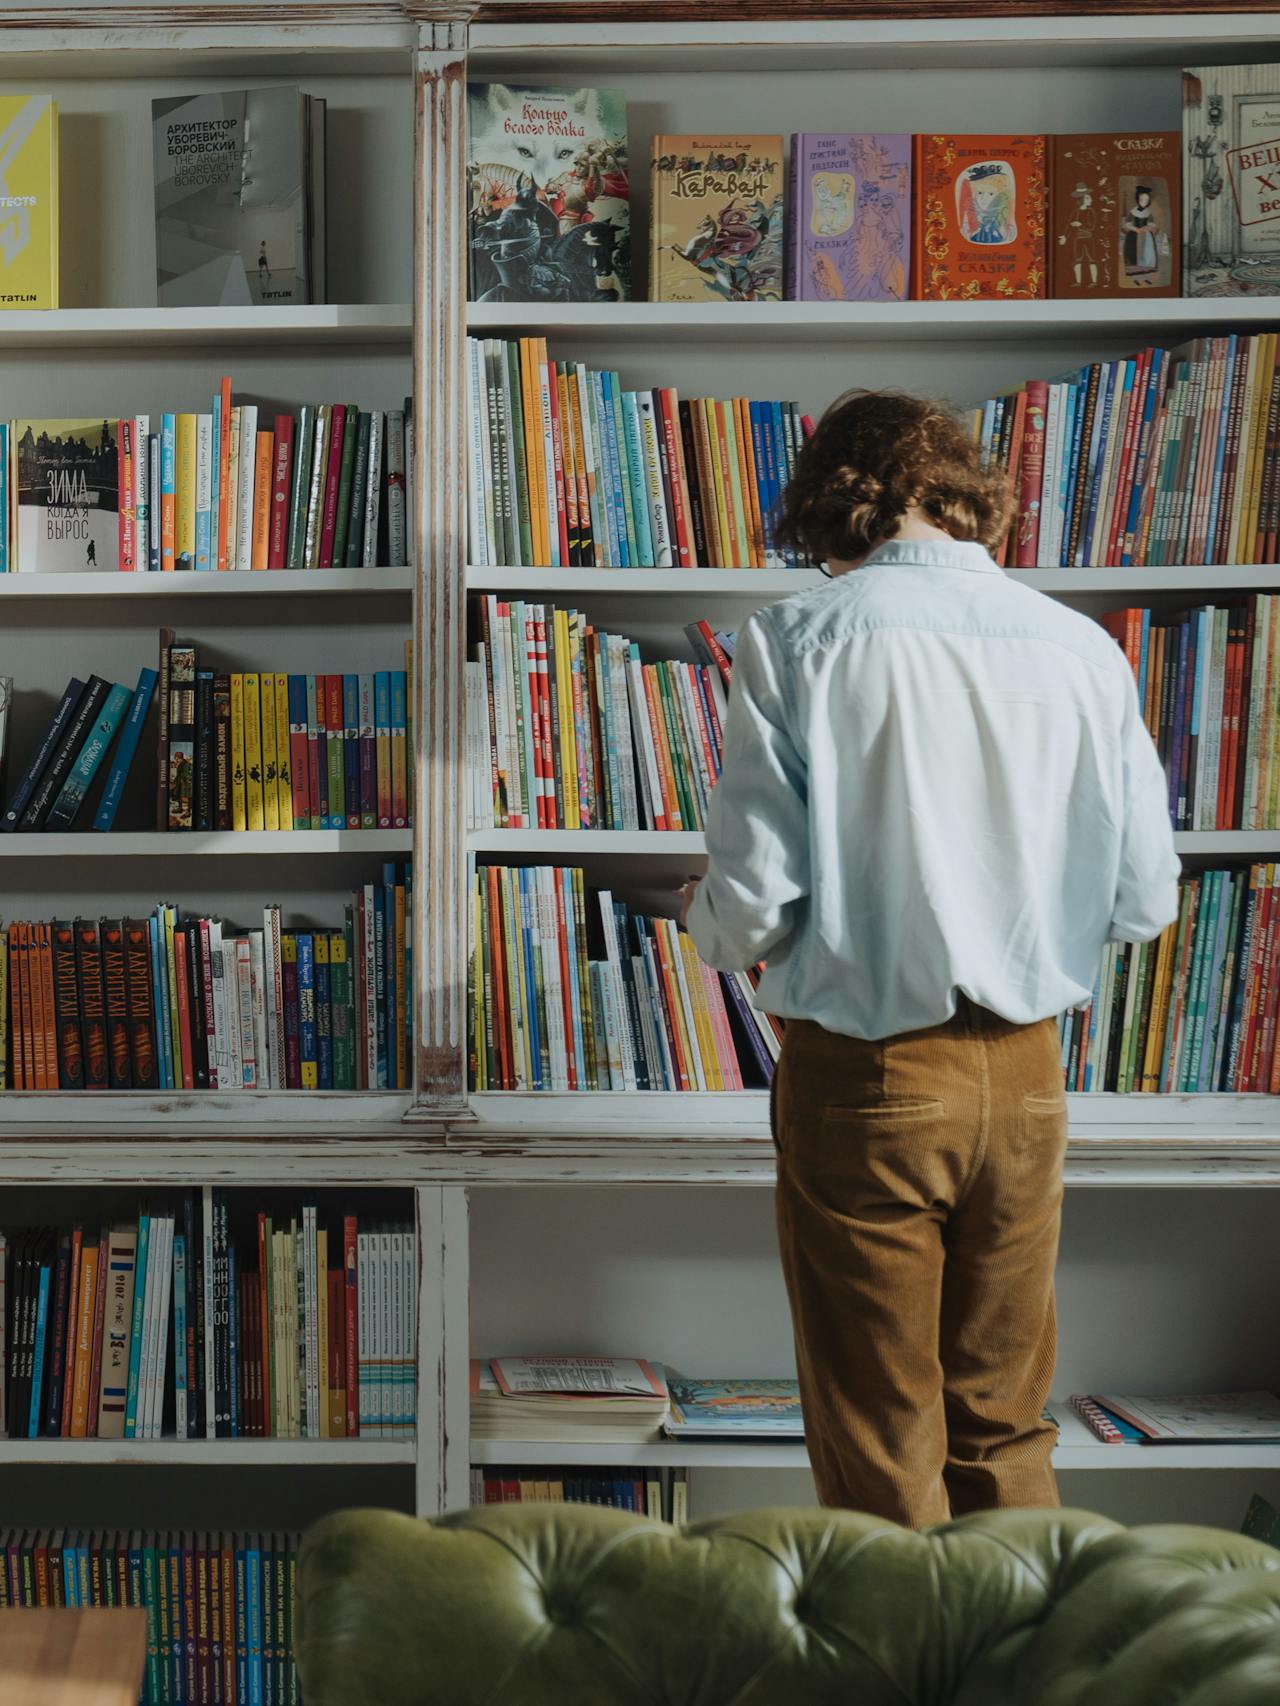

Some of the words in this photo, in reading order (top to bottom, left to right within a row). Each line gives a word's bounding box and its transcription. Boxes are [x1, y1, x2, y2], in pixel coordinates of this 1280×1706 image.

[520, 103, 567, 123] Кольцо
[166, 119, 238, 135] АРХИТЕКТОР
[502, 118, 545, 135] белого
[545, 120, 584, 137] волка
[167, 132, 229, 146] УБОРЕВИЧ-
[167, 140, 236, 156] БОРОВСКИЙ
[1117, 137, 1165, 151] СКАЗКИ
[173, 154, 195, 166] THE
[196, 149, 254, 165] ARCHITECT
[174, 173, 230, 187] BOROVSKY
[670, 170, 768, 199] Караван
[959, 263, 1016, 274] СКАЗКИ
[1099, 392, 1114, 439] СКАЗКИ
[47, 506, 80, 520] КОГДА
[82, 506, 89, 519] Я
[47, 519, 89, 540] ВЫРОС
[216, 722, 227, 753] ЗАМОК
[216, 753, 227, 811] ВОЗДУШНЫЙ
[57, 951, 78, 1018] ДАРИТЕЛИ
[80, 951, 103, 1018] ДАРИТЕЛИ
[104, 951, 126, 1018] ДАРИТЕЛИ
[127, 951, 150, 1018] ДАРИТЕЛИ
[81, 1263, 93, 1315] университет
[112, 1274, 127, 1300] 2018
[79, 1315, 90, 1351] Детский
